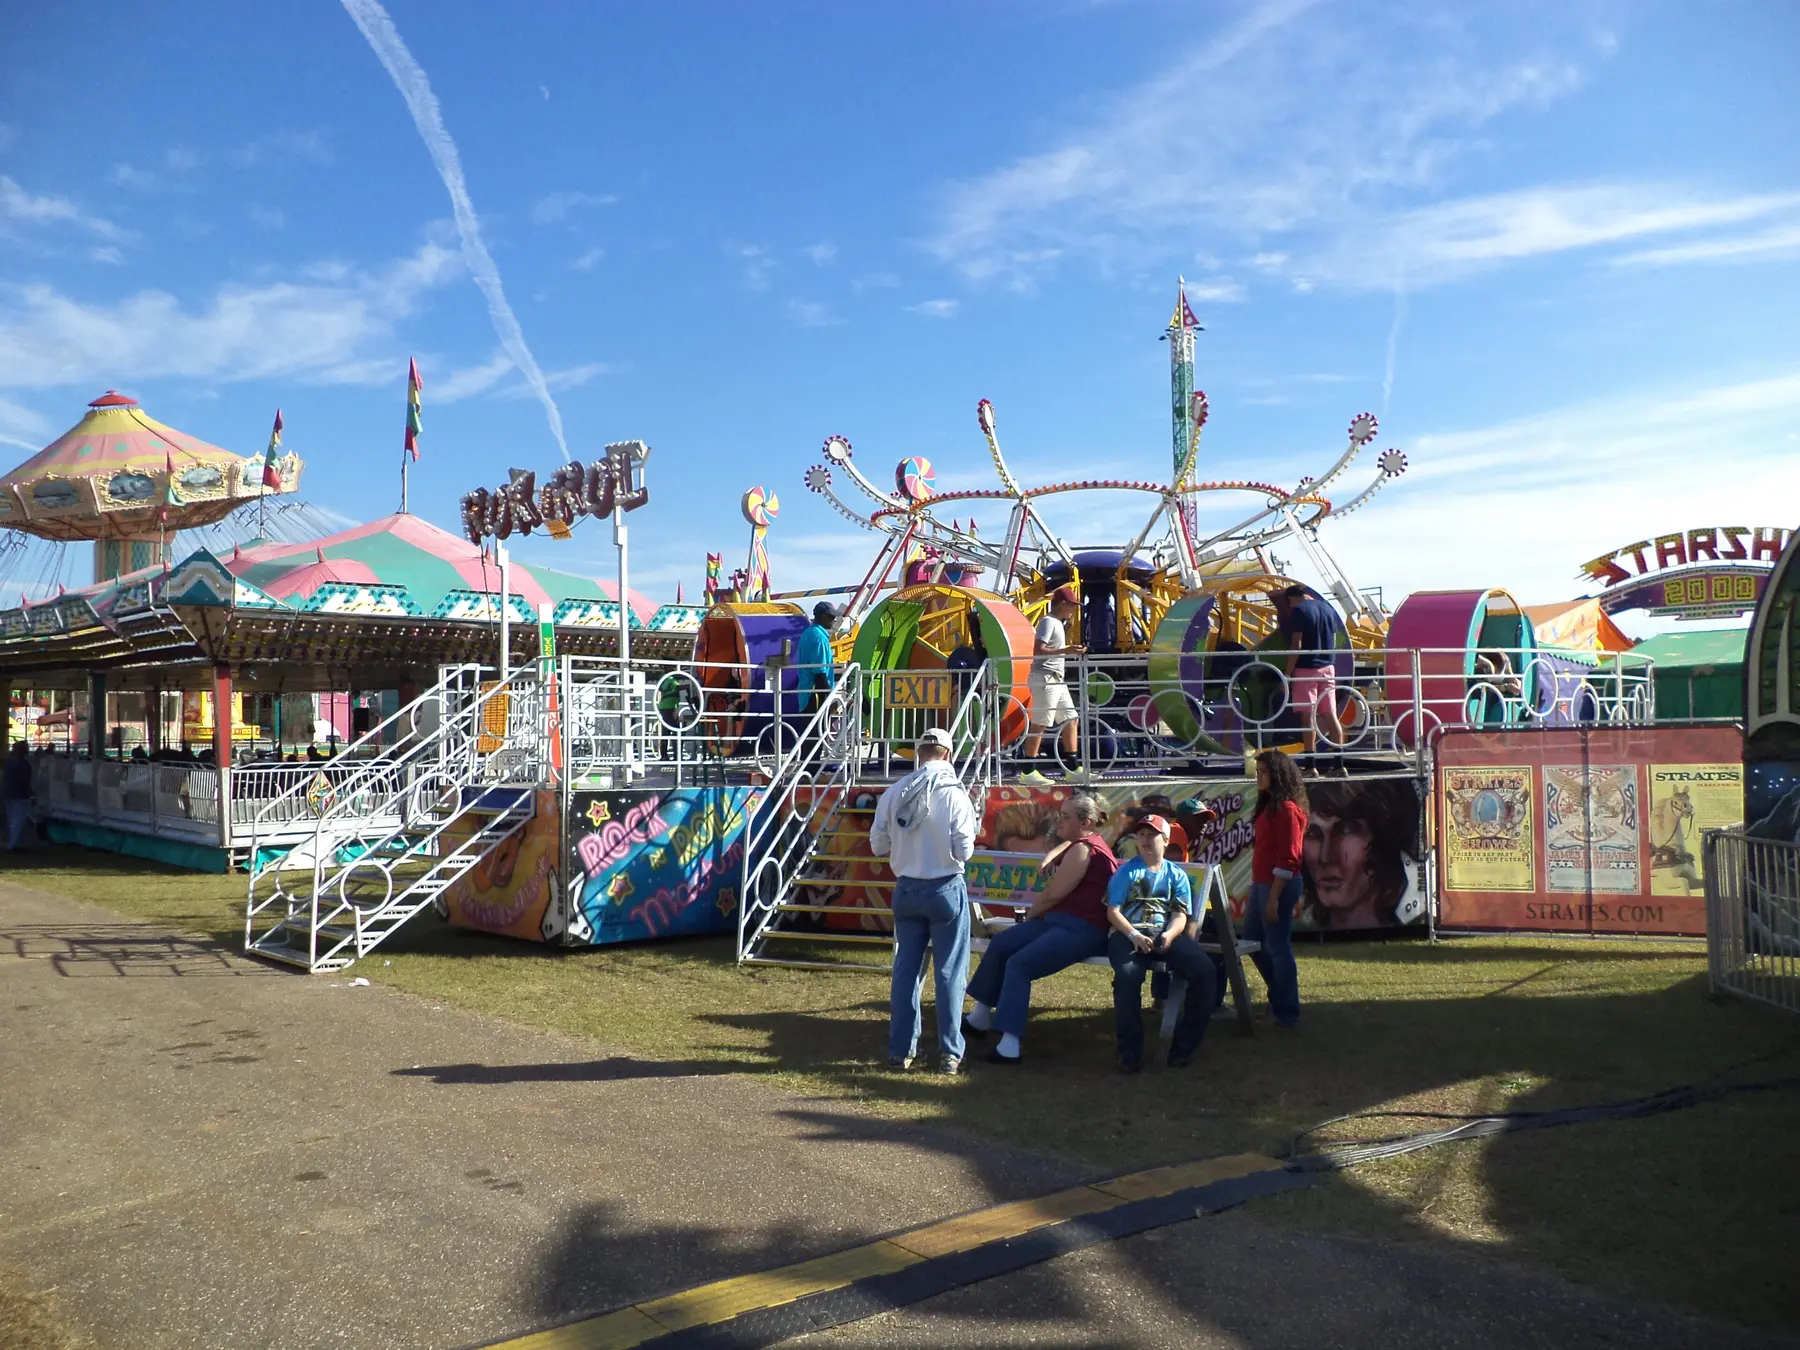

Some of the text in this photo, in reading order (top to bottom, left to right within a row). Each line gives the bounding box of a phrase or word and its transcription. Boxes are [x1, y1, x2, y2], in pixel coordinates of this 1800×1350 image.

[1664, 575, 1756, 605] 2000
[889, 676, 948, 704] EXIT
[548, 712, 558, 728] NO
[1451, 775, 1525, 790] STRATES
[1655, 772, 1740, 782] STRATES
[577, 796, 669, 878] ROCK
[1460, 838, 1518, 850] SHOWS
